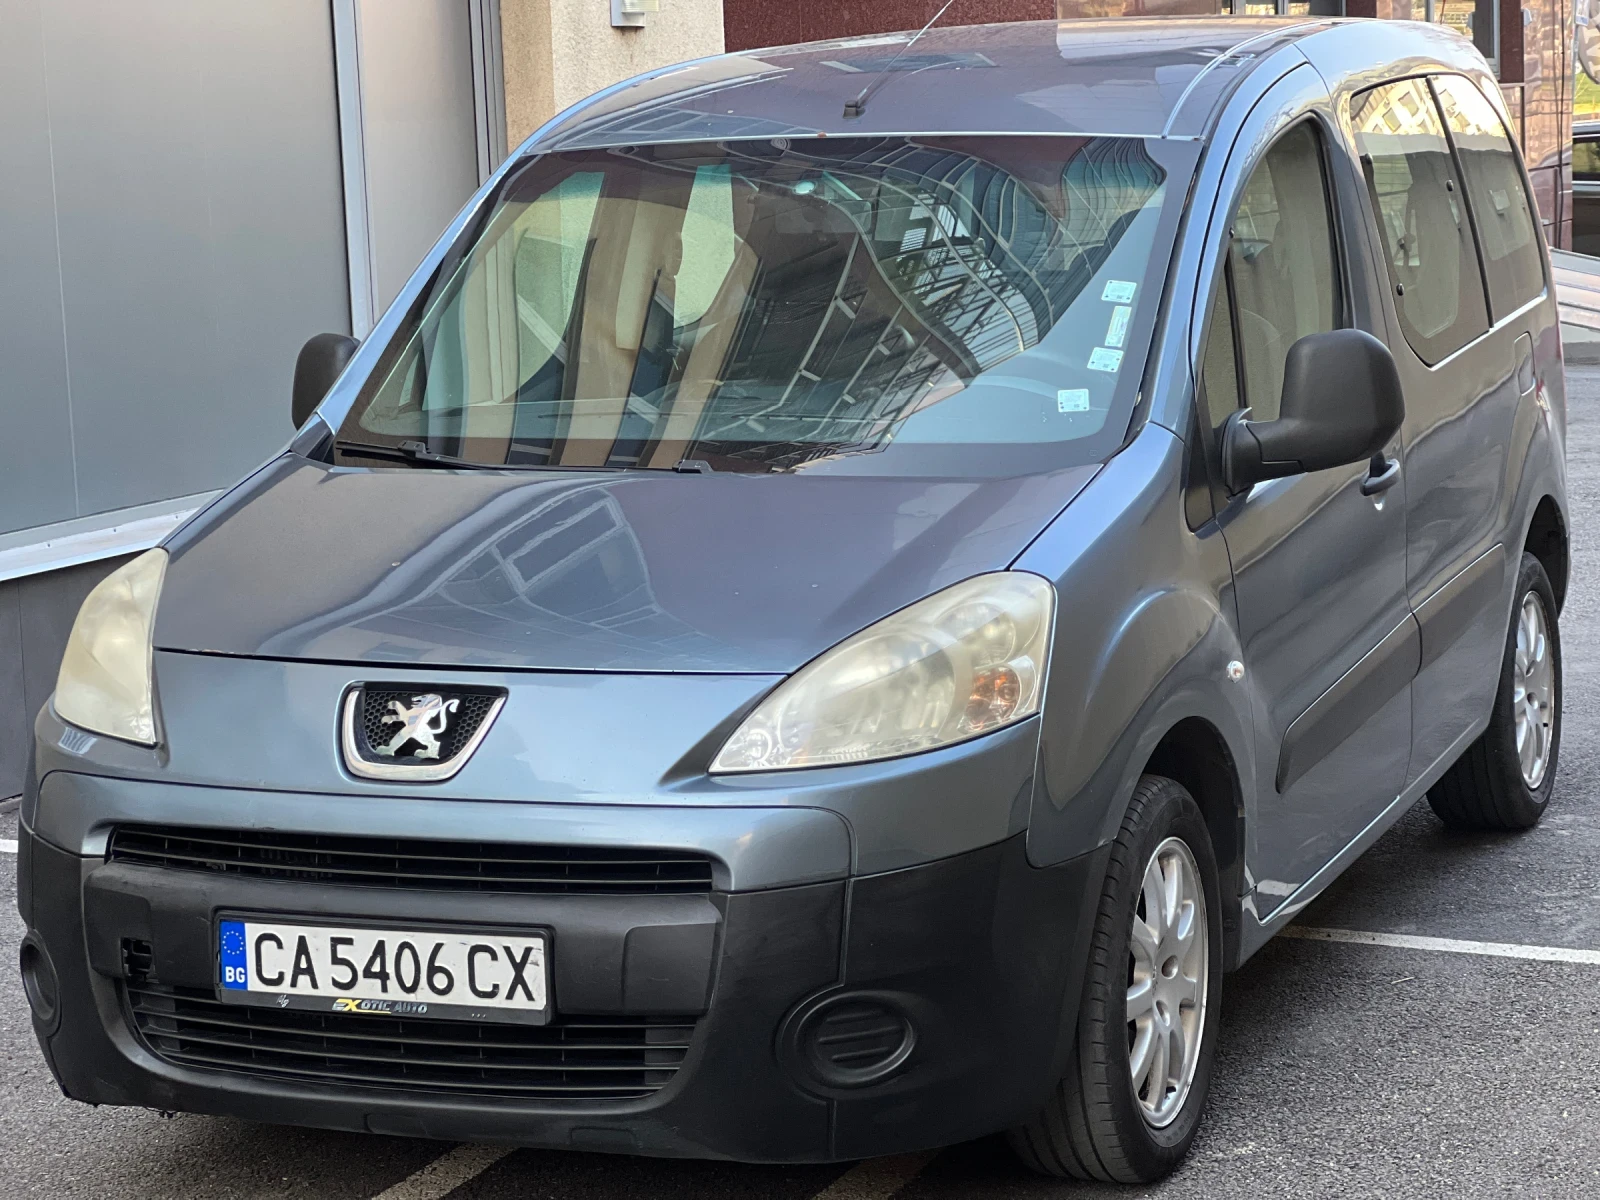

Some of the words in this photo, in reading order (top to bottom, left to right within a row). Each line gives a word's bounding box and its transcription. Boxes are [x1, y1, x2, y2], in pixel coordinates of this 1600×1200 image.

[225, 966, 246, 984] BG
[254, 932, 319, 990] CA
[329, 936, 455, 996] 5406
[467, 943, 536, 1001] CX
[393, 1002, 428, 1014] AUTO
